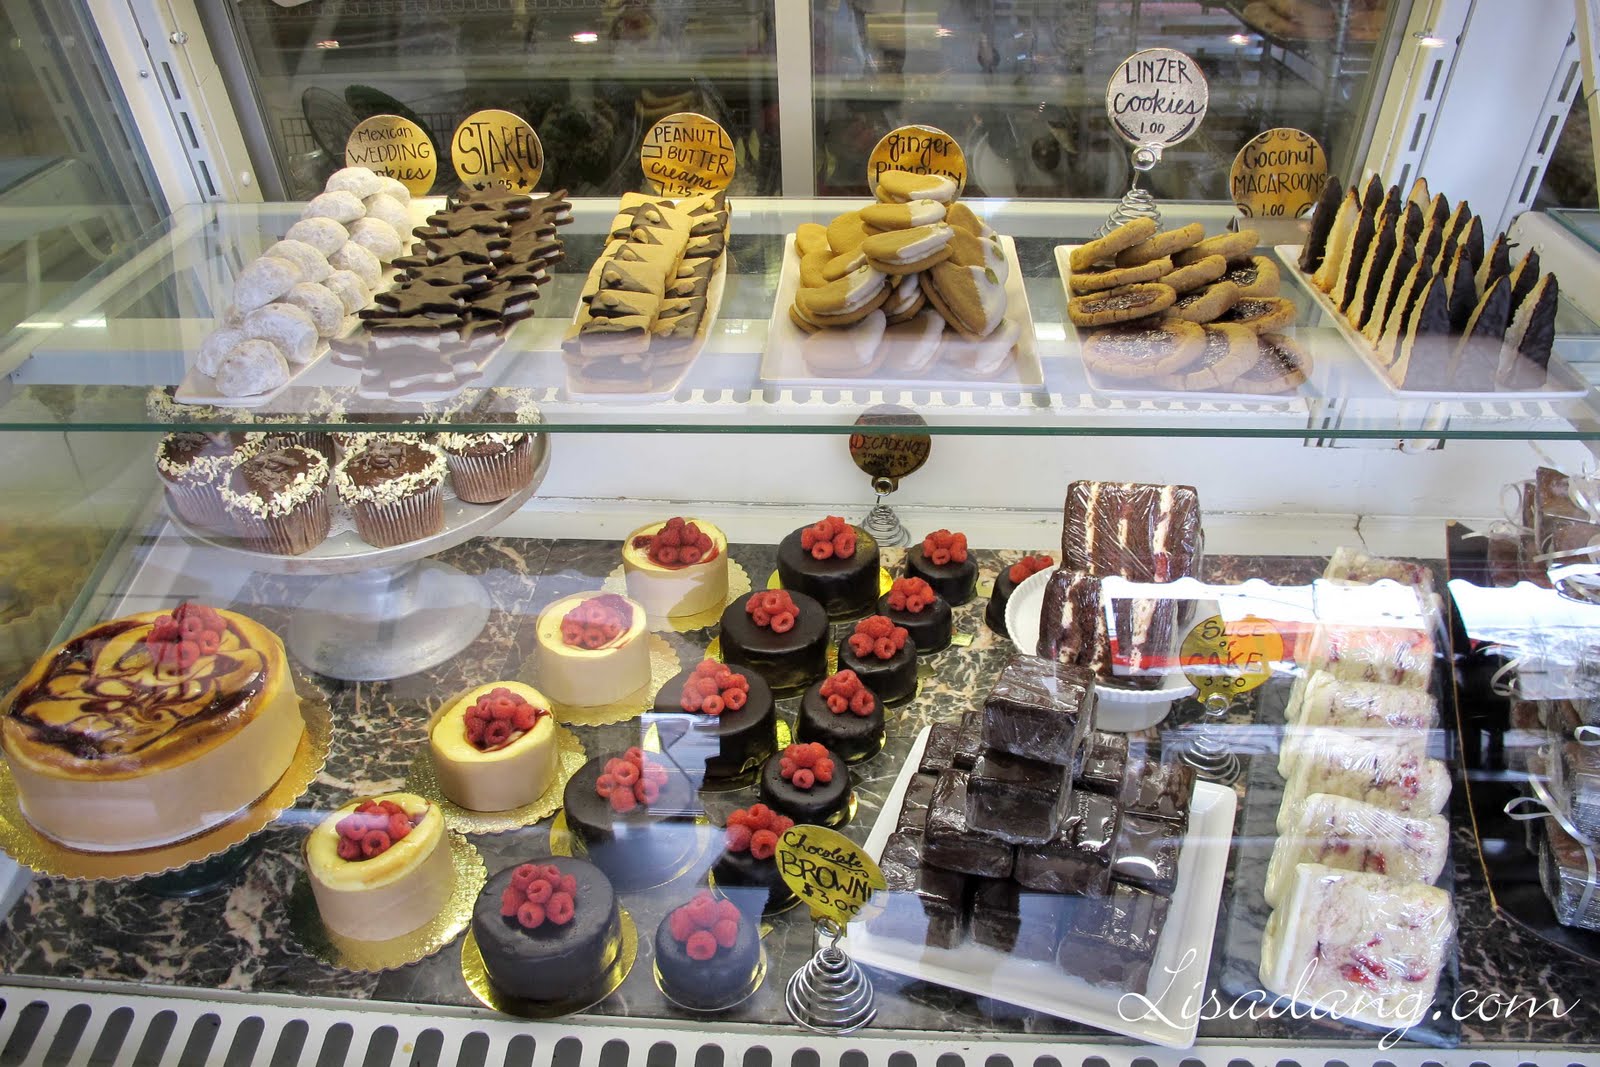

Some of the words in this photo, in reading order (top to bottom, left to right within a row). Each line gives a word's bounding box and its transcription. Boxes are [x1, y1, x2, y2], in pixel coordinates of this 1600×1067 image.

[1125, 58, 1193, 84] LINZER
[1113, 88, 1205, 115] Cookies
[358, 126, 413, 143] Mexican
[654, 126, 717, 145] PEANUT
[1140, 122, 1166, 134] 1.00
[347, 142, 430, 164] WEDDING
[458, 122, 539, 176] STAREO
[887, 133, 952, 167] ginger
[1243, 141, 1318, 170] Coconut
[667, 146, 729, 177] BUTTER
[669, 183, 692, 198] 1.25
[1233, 172, 1326, 197] MACAROONS
[1261, 203, 1285, 217] 1.00
[1201, 620, 1266, 640] SLICE
[1187, 651, 1264, 673] CAKE
[1203, 676, 1246, 688] 3.50
[783, 831, 864, 869] Chocolate
